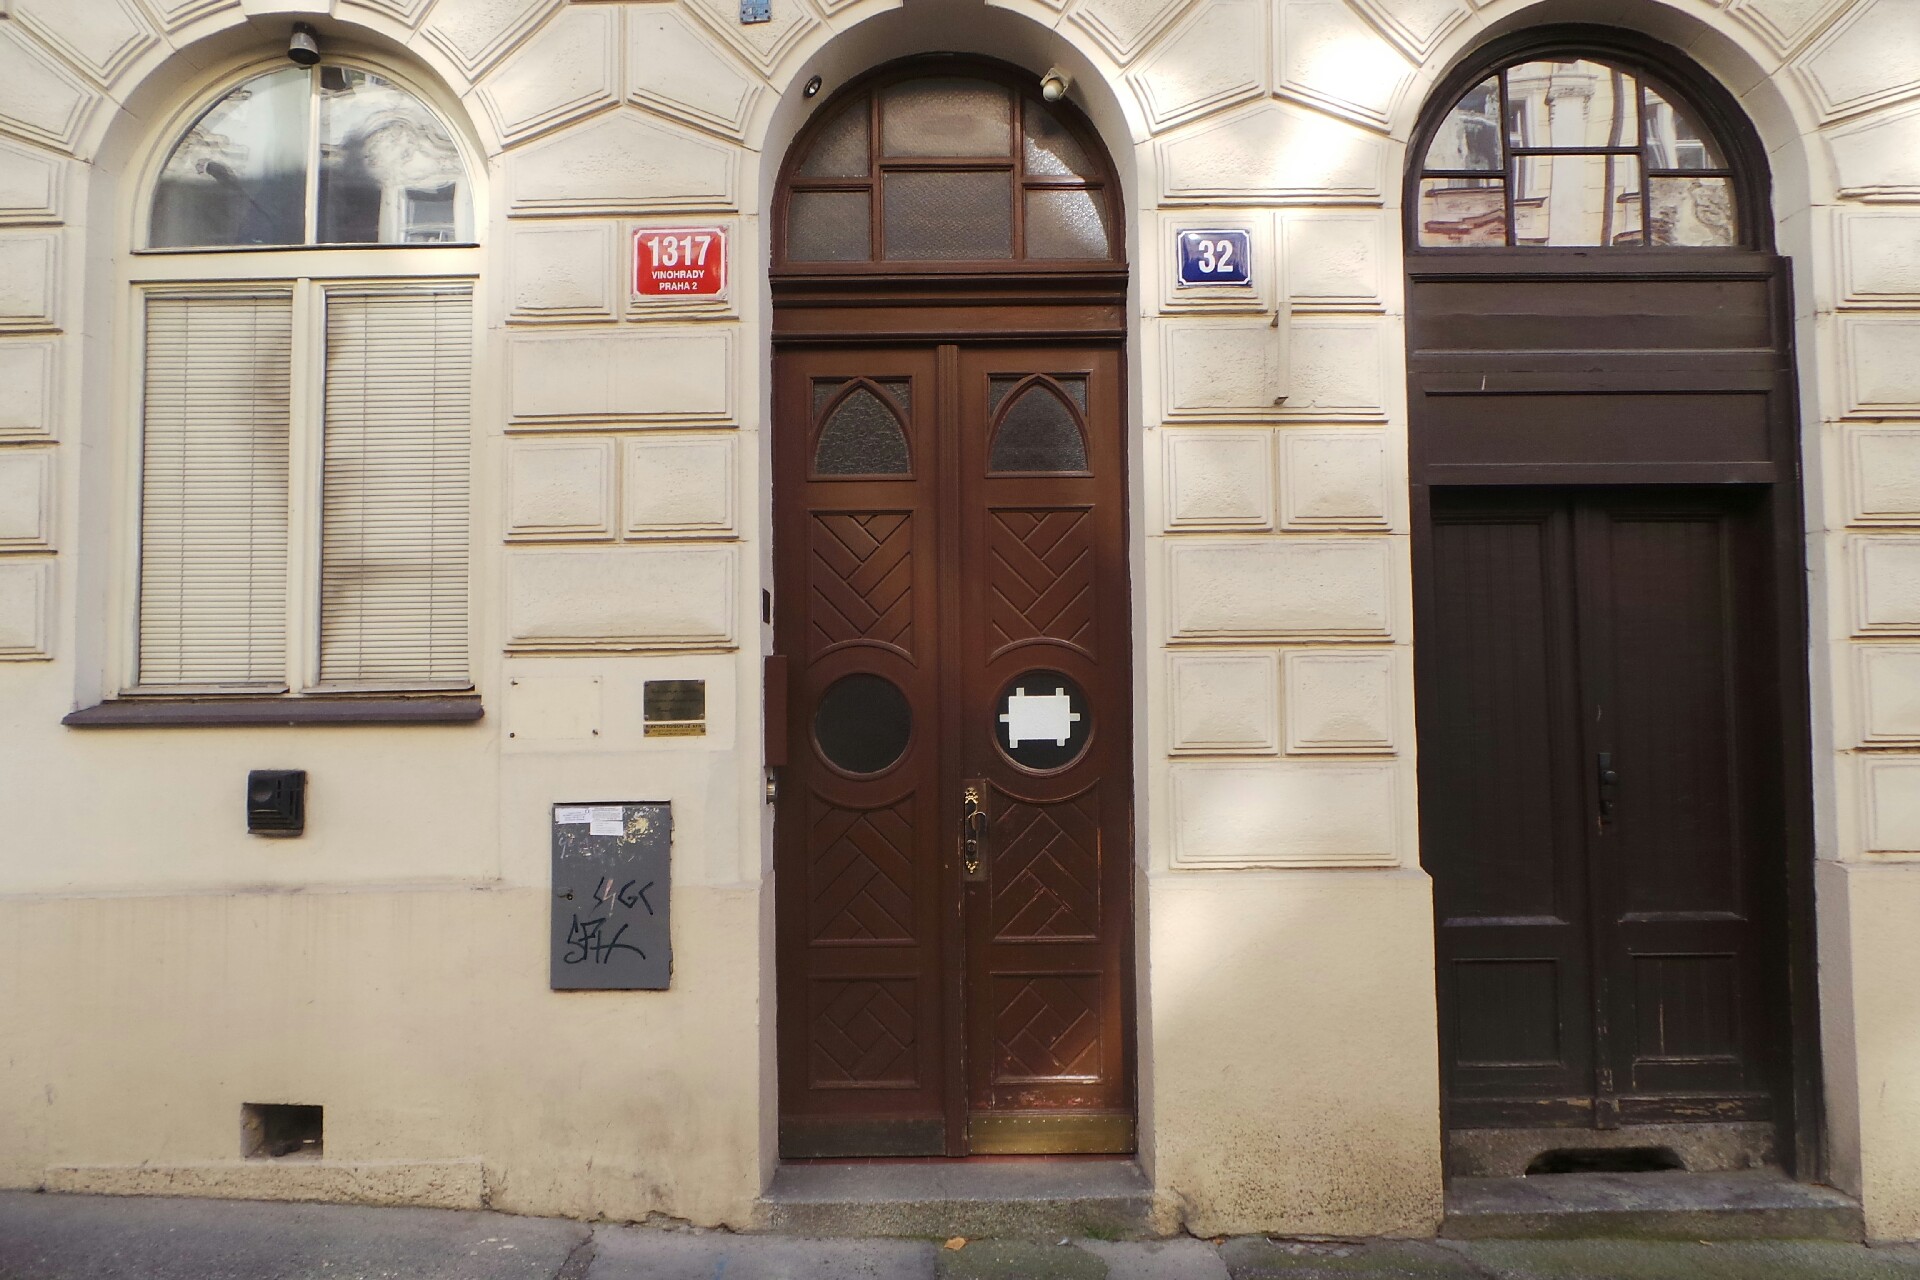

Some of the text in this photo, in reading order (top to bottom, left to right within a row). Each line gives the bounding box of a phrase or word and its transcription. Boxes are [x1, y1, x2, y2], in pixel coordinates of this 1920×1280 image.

[647, 235, 711, 266] 1317
[1198, 240, 1233, 273] 32
[652, 270, 704, 279] VINOHRADY
[659, 282, 690, 290] PRAHA
